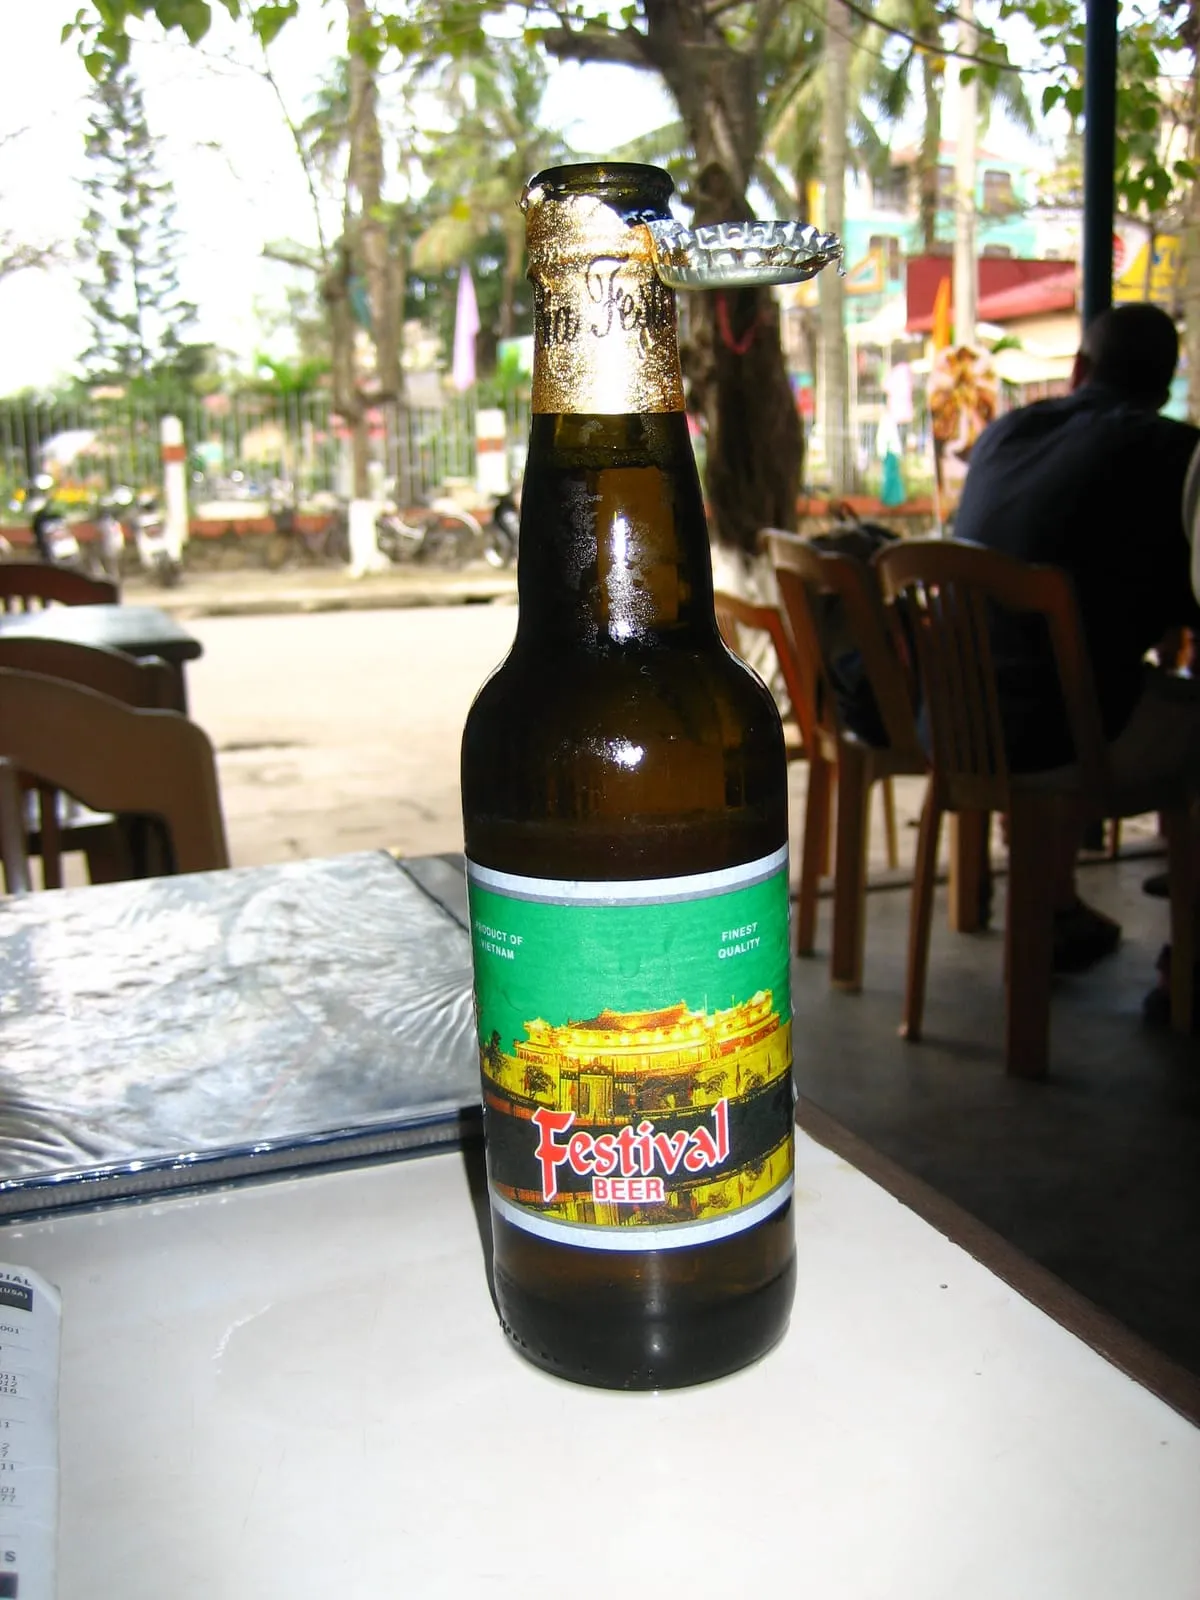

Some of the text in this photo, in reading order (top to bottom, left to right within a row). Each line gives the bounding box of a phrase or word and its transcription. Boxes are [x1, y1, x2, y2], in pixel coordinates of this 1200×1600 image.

[510, 934, 523, 946] OF
[721, 921, 758, 942] FINEST
[480, 938, 515, 960] VIETNAM
[718, 936, 760, 959] QUALITY
[531, 1097, 730, 1202] Festival
[592, 1177, 665, 1203] BEER
